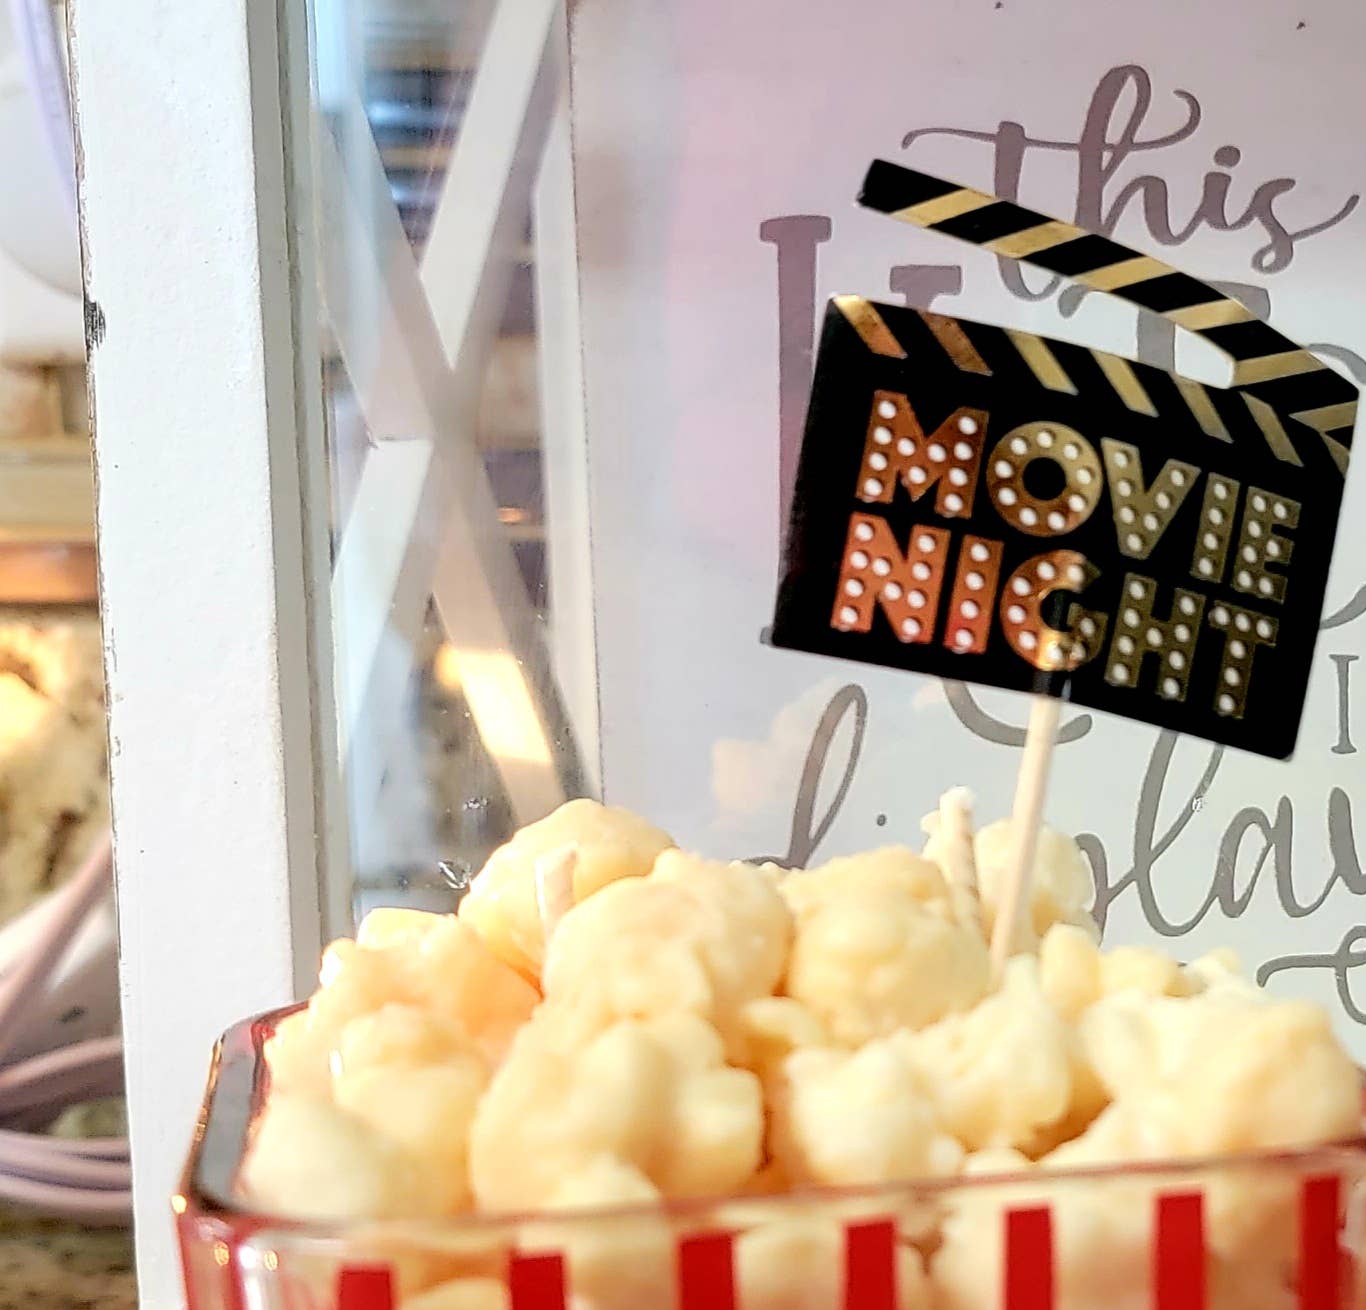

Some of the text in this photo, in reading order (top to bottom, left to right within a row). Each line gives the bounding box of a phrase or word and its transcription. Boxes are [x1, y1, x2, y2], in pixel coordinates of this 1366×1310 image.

[902, 64, 1360, 317] this
[855, 390, 1302, 603] MOVIE
[830, 511, 1280, 720] NIGHT
